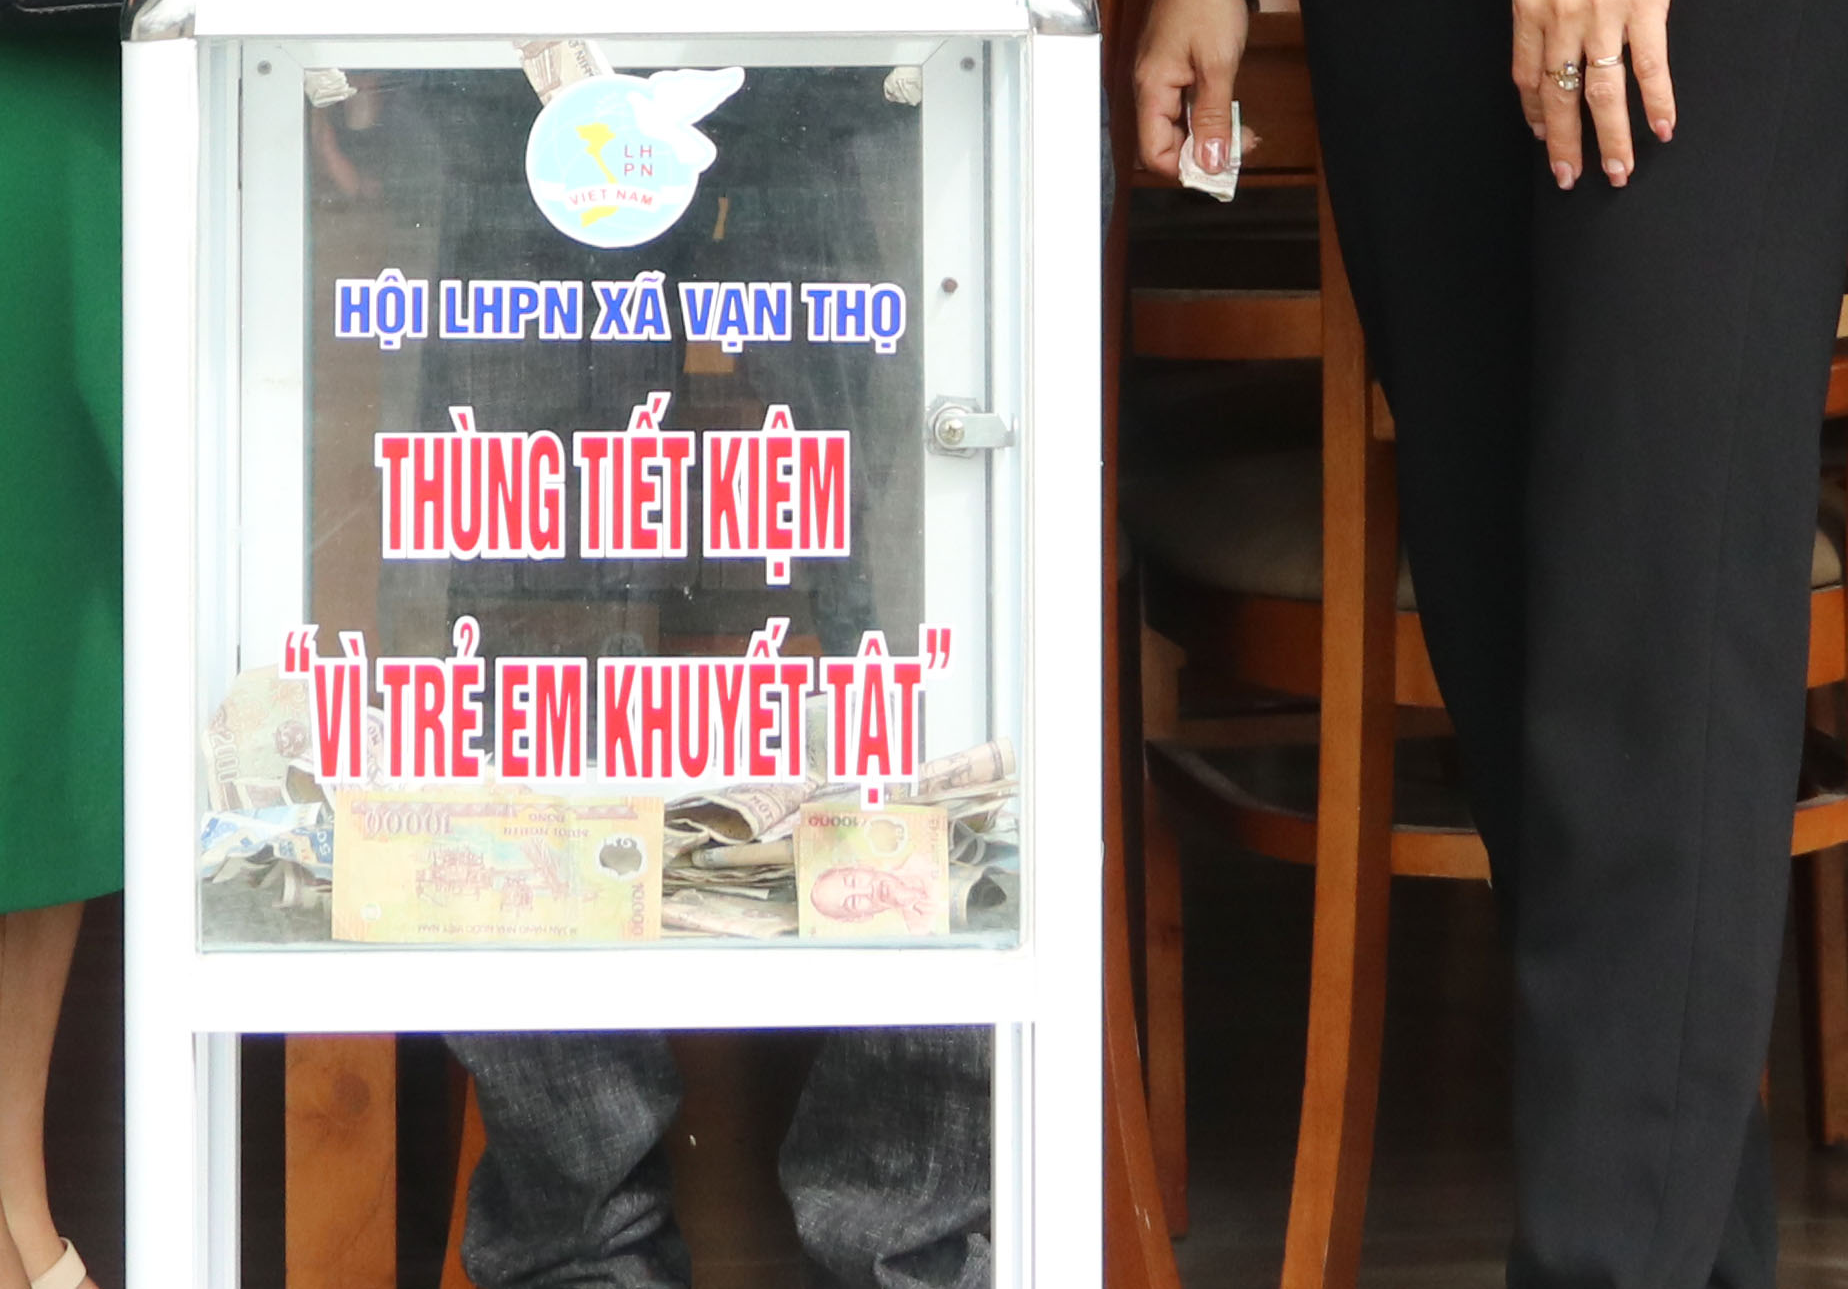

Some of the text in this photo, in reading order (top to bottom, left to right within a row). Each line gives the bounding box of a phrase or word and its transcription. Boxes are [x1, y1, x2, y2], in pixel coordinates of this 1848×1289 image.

[616, 189, 653, 206] NAM
[337, 269, 903, 352] HỘI LHPN XÃ VẠN THỌ
[377, 392, 851, 584] THÙNG TIẾT KIỆM
[378, 619, 487, 778] TRẺ
[497, 658, 586, 778] EM
[598, 619, 815, 778] KHUYẾT
